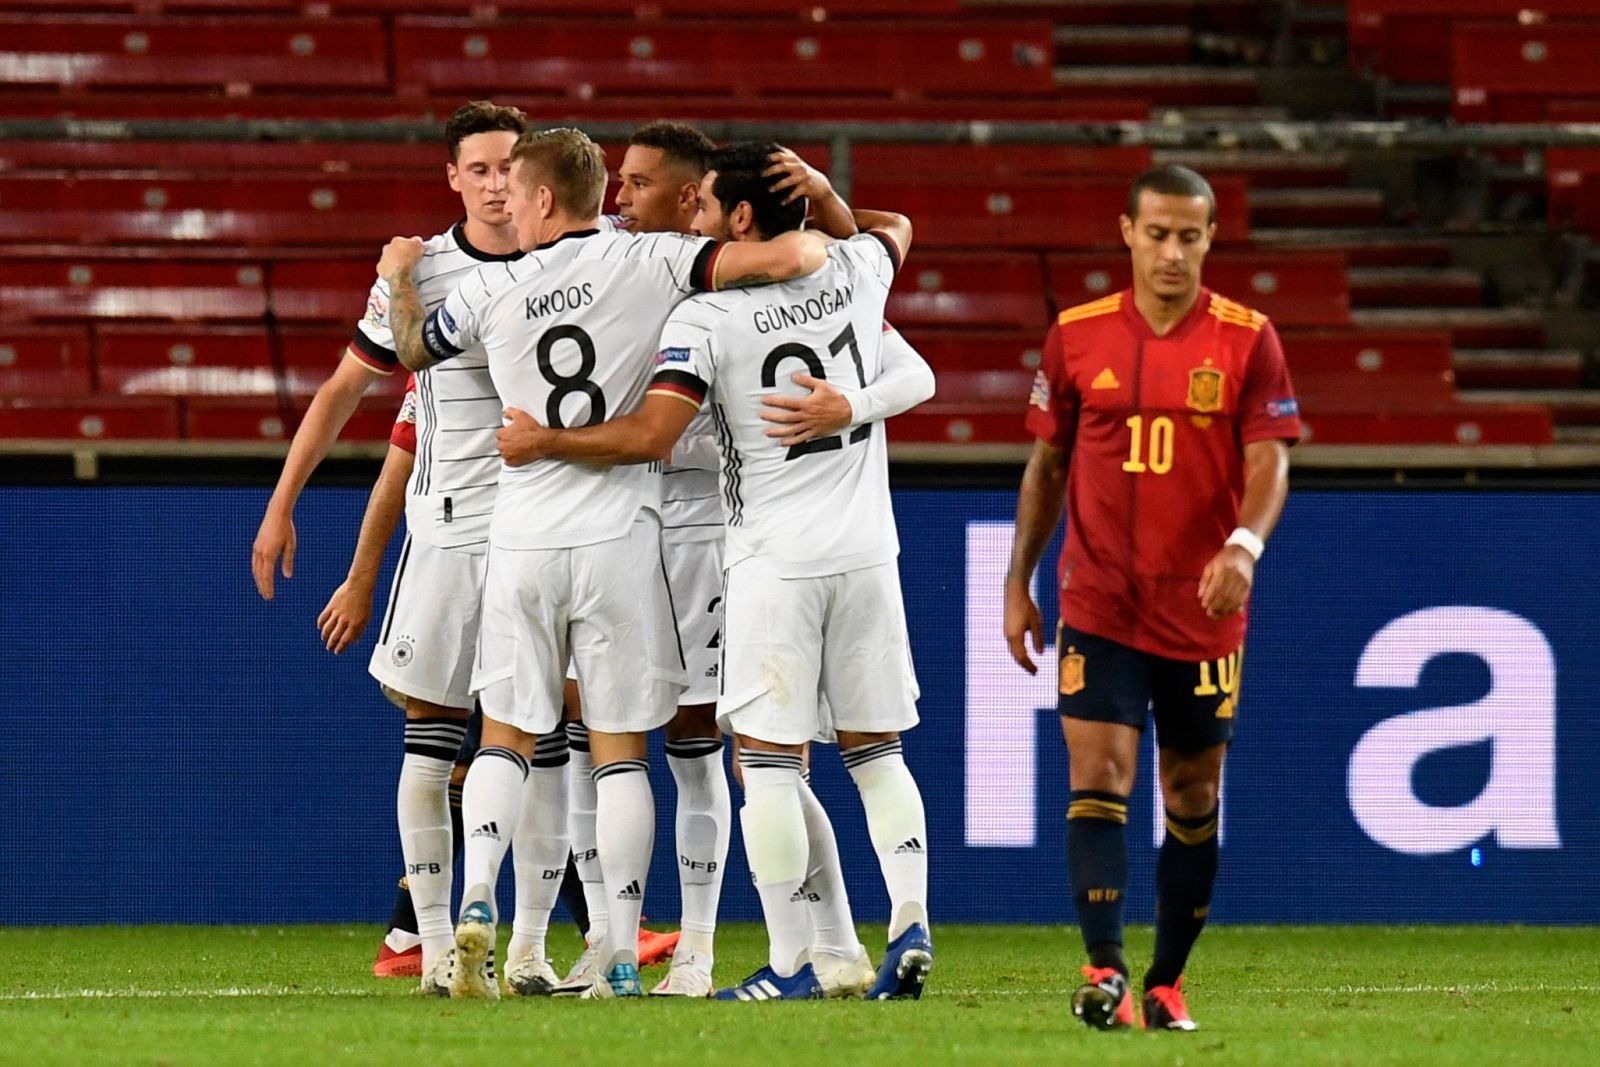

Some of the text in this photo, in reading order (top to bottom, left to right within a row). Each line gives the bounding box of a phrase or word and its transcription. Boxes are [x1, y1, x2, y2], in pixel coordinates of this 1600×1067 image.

[525, 282, 593, 320] KROOS
[753, 283, 855, 334] GÜNDOĞAN
[536, 324, 607, 429] 8
[761, 321, 873, 462] 21
[1121, 414, 1175, 475] 10
[1193, 650, 1236, 697] 10
[408, 862, 441, 875] DFB
[679, 854, 718, 873] DFB
